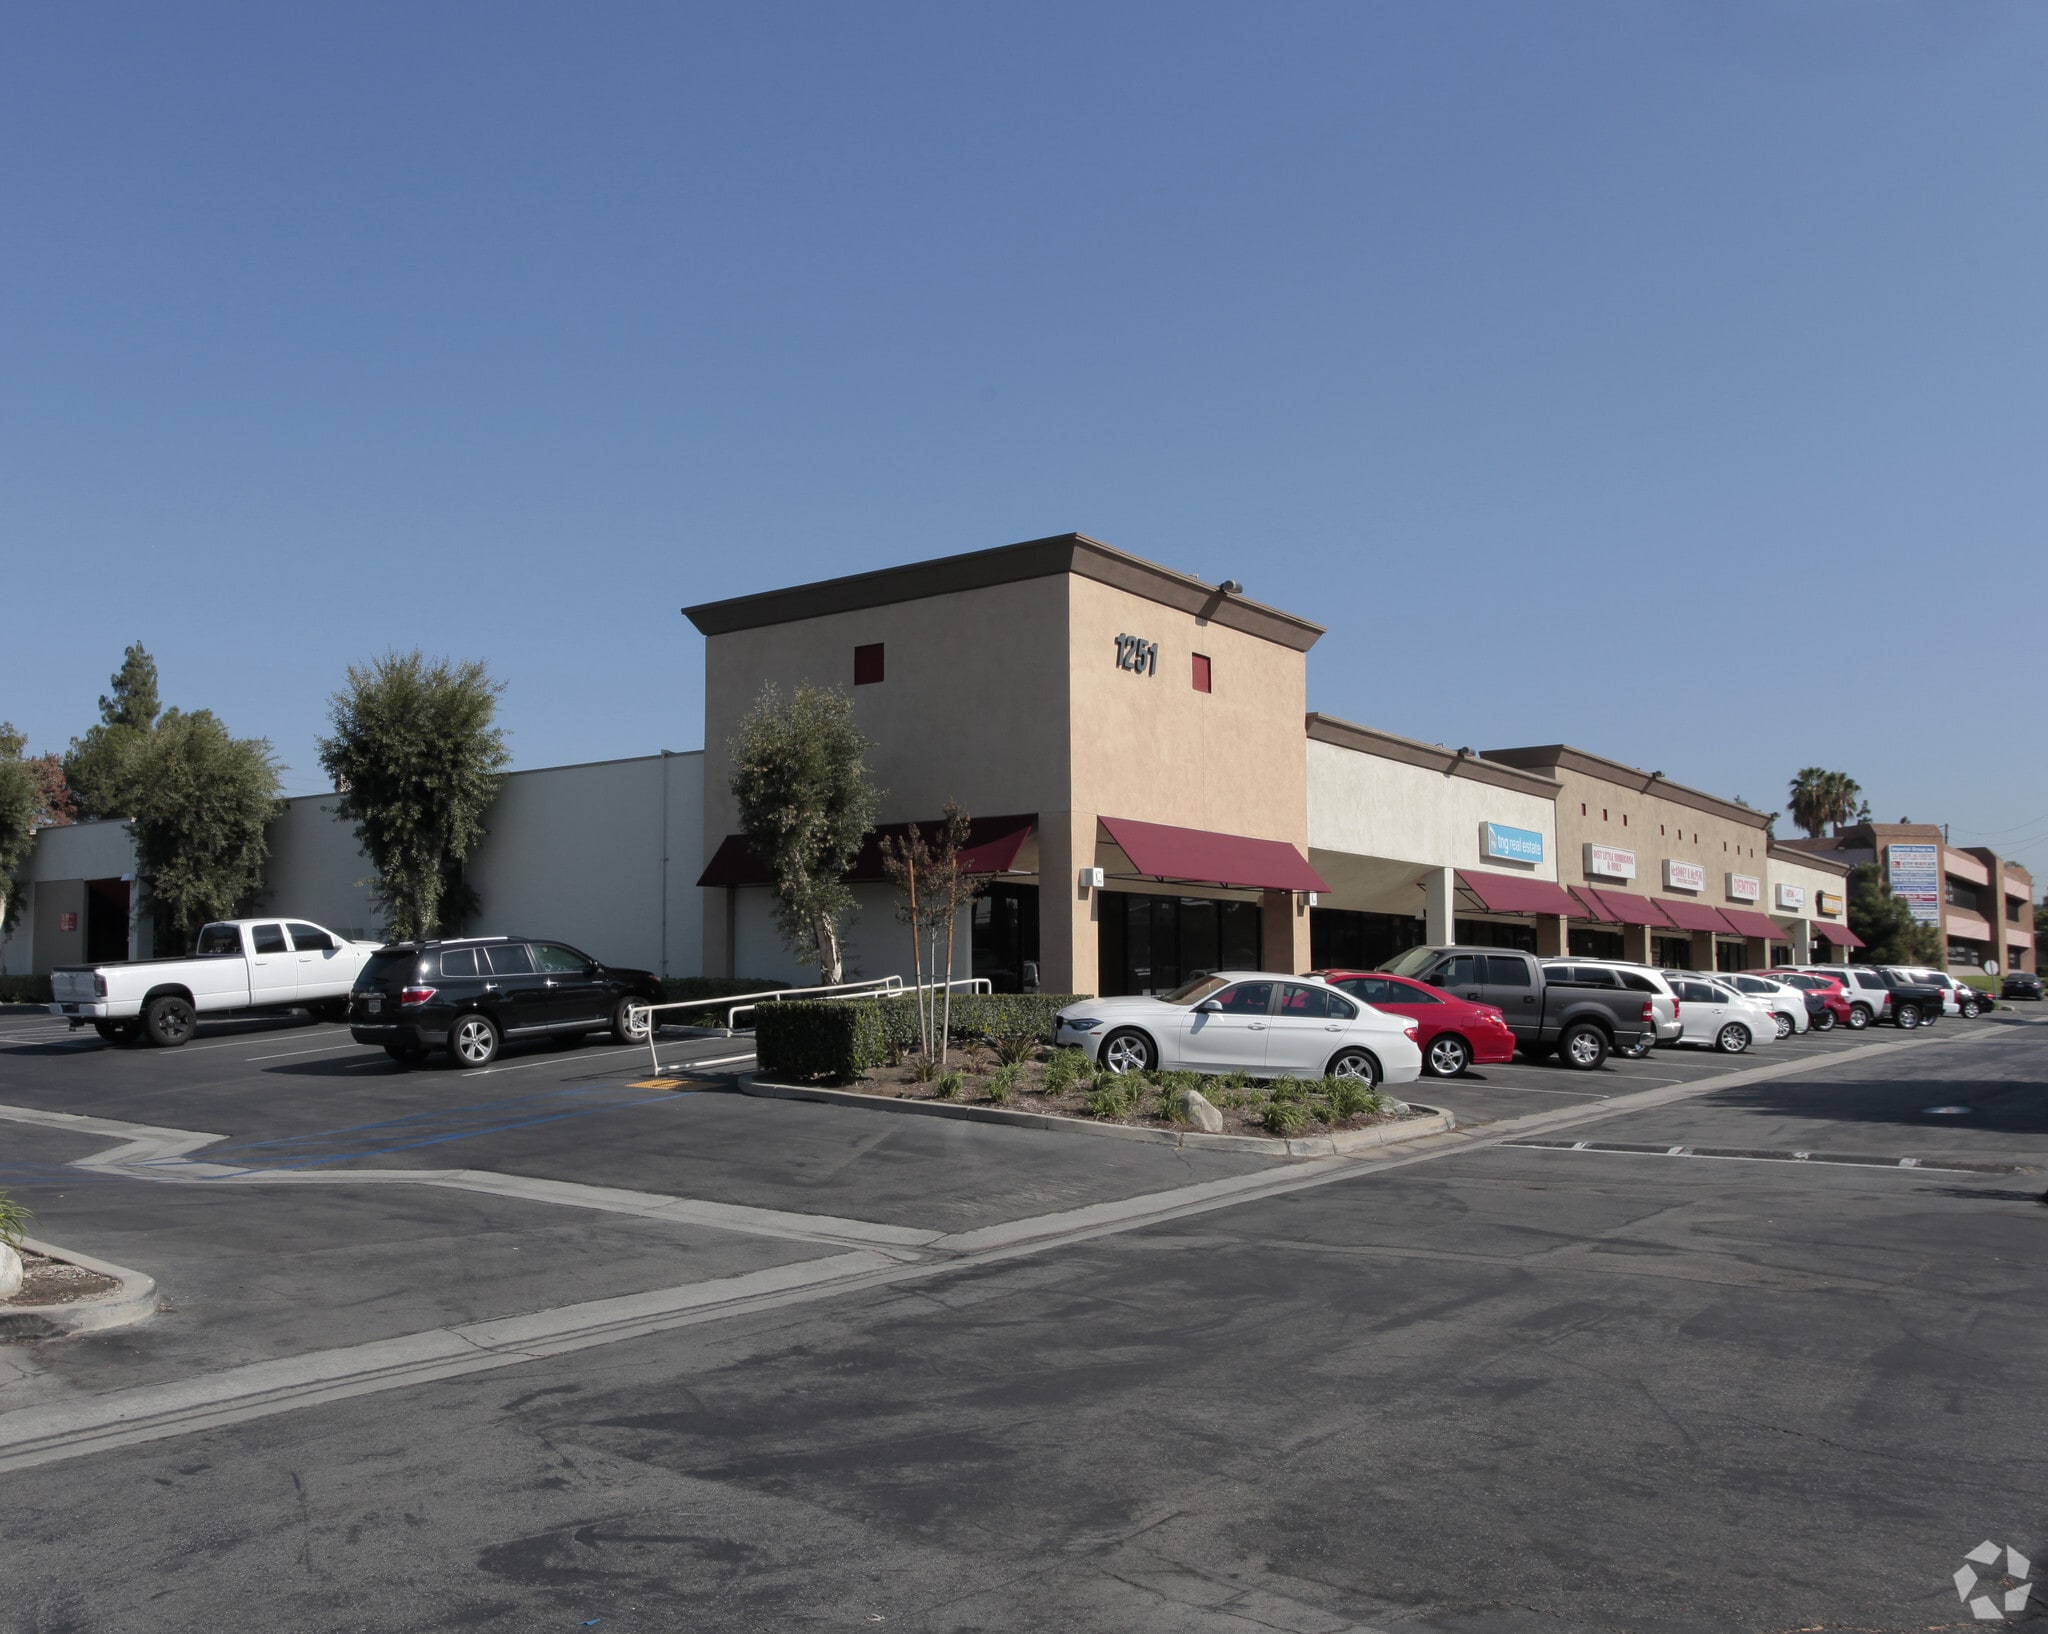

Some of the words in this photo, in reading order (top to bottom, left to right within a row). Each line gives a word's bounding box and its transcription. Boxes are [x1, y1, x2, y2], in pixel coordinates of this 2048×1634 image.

[1115, 633, 1158, 676] 1251
[1498, 835, 1508, 854] tng
[1509, 837, 1521, 851] real
[1523, 840, 1541, 855] estate
[1603, 851, 1614, 861] LITTLE
[1734, 878, 1758, 896] DENTIST
